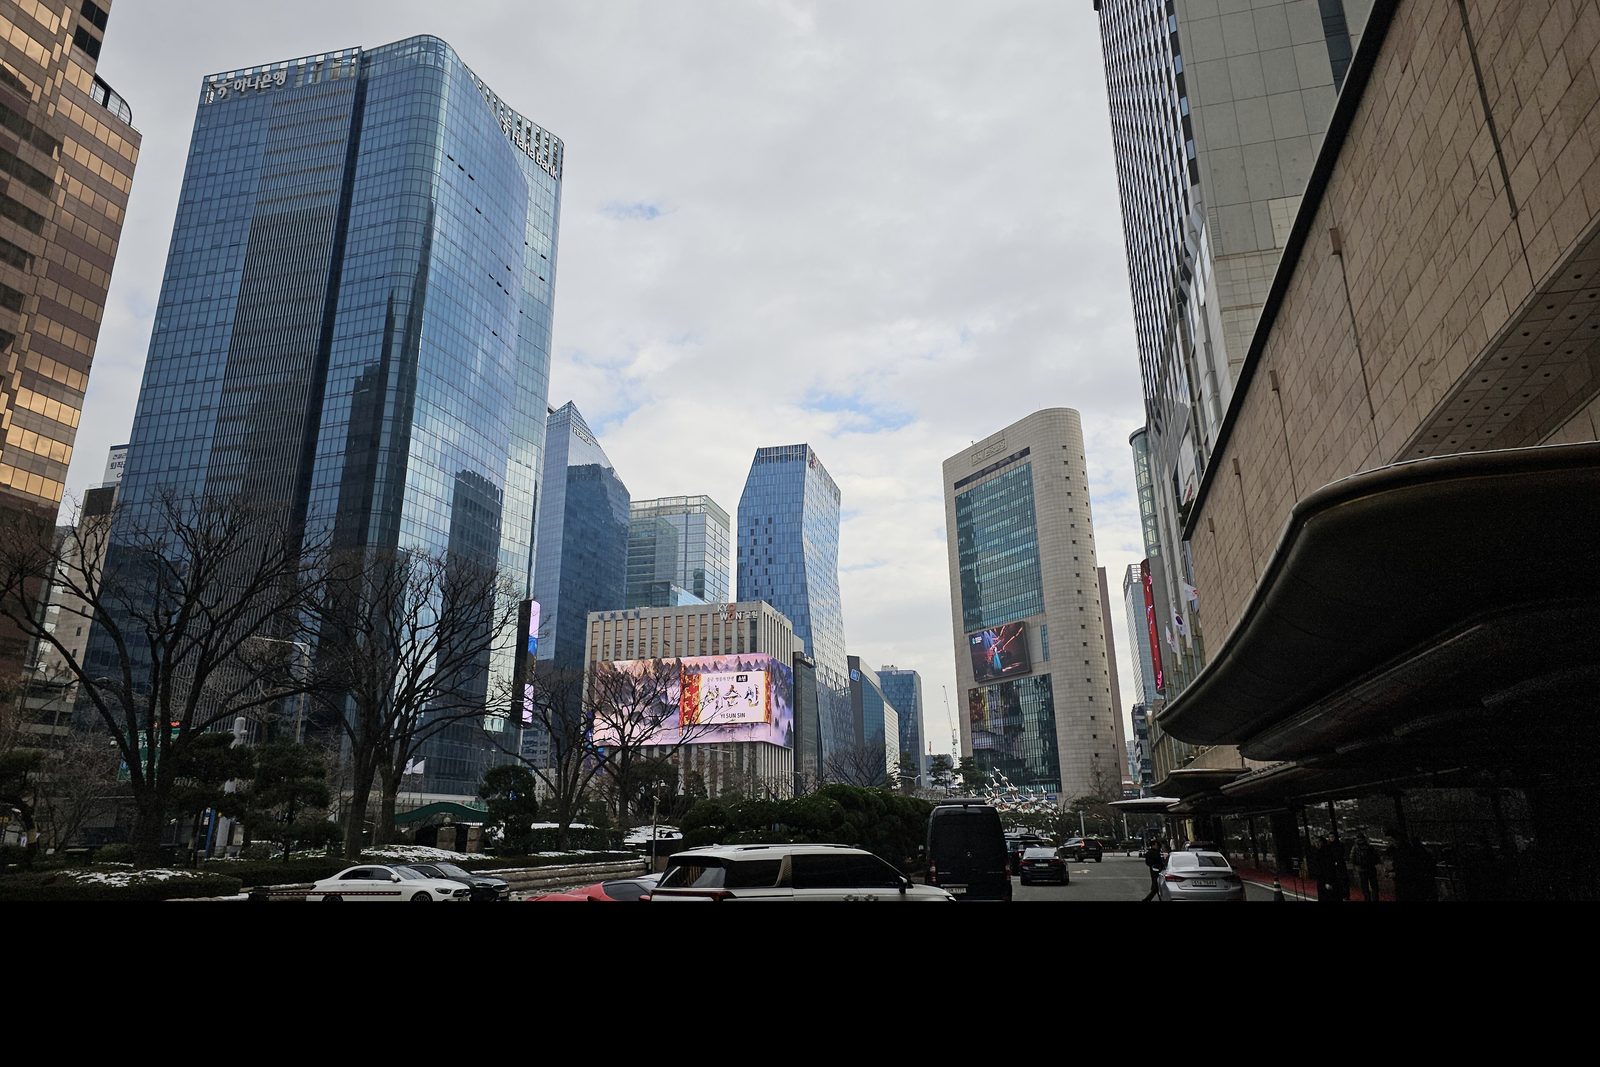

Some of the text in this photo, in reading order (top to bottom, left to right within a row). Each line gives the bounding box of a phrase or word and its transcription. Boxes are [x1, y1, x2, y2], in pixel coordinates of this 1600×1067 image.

[233, 70, 287, 92] 하나은행
[511, 129, 558, 180] Hana Bank
[717, 603, 736, 612] KYO
[720, 612, 743, 621] WON
